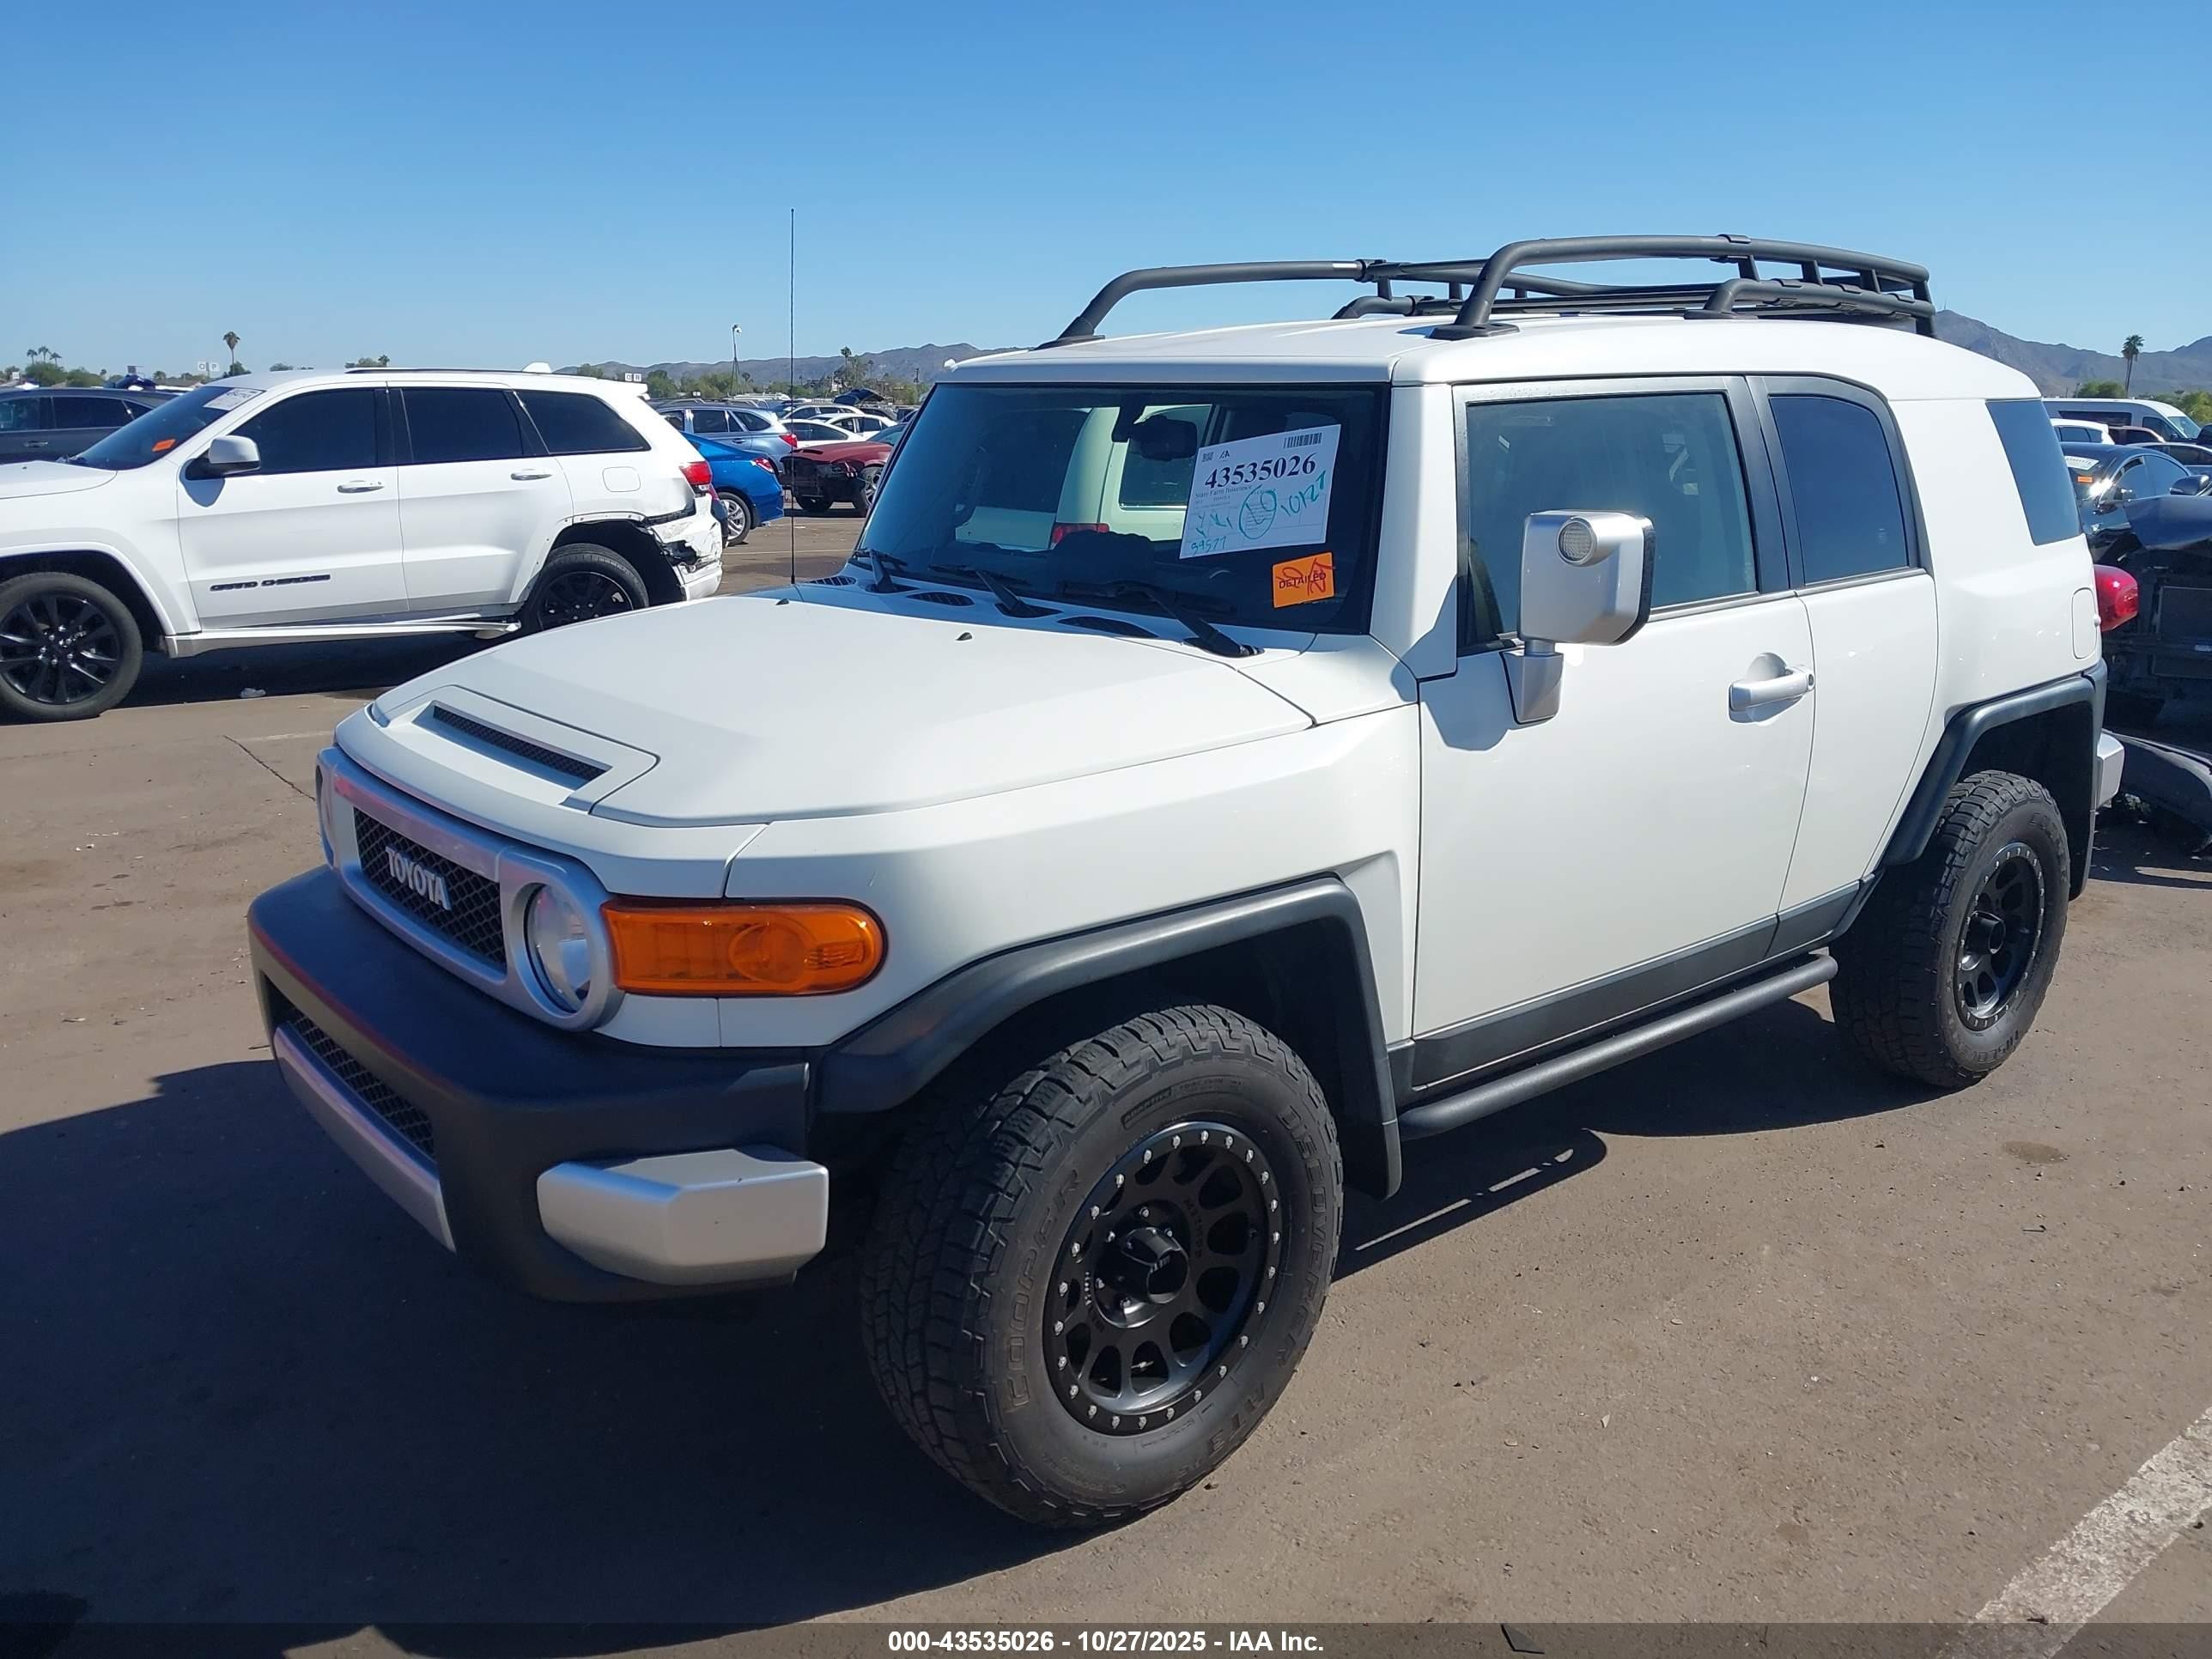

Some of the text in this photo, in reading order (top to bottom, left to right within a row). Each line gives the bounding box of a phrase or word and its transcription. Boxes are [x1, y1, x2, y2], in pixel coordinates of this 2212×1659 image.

[1205, 452, 1317, 489] 43535026
[386, 846, 452, 911] TOYOTA
[1007, 1169, 1081, 1407] COOPER
